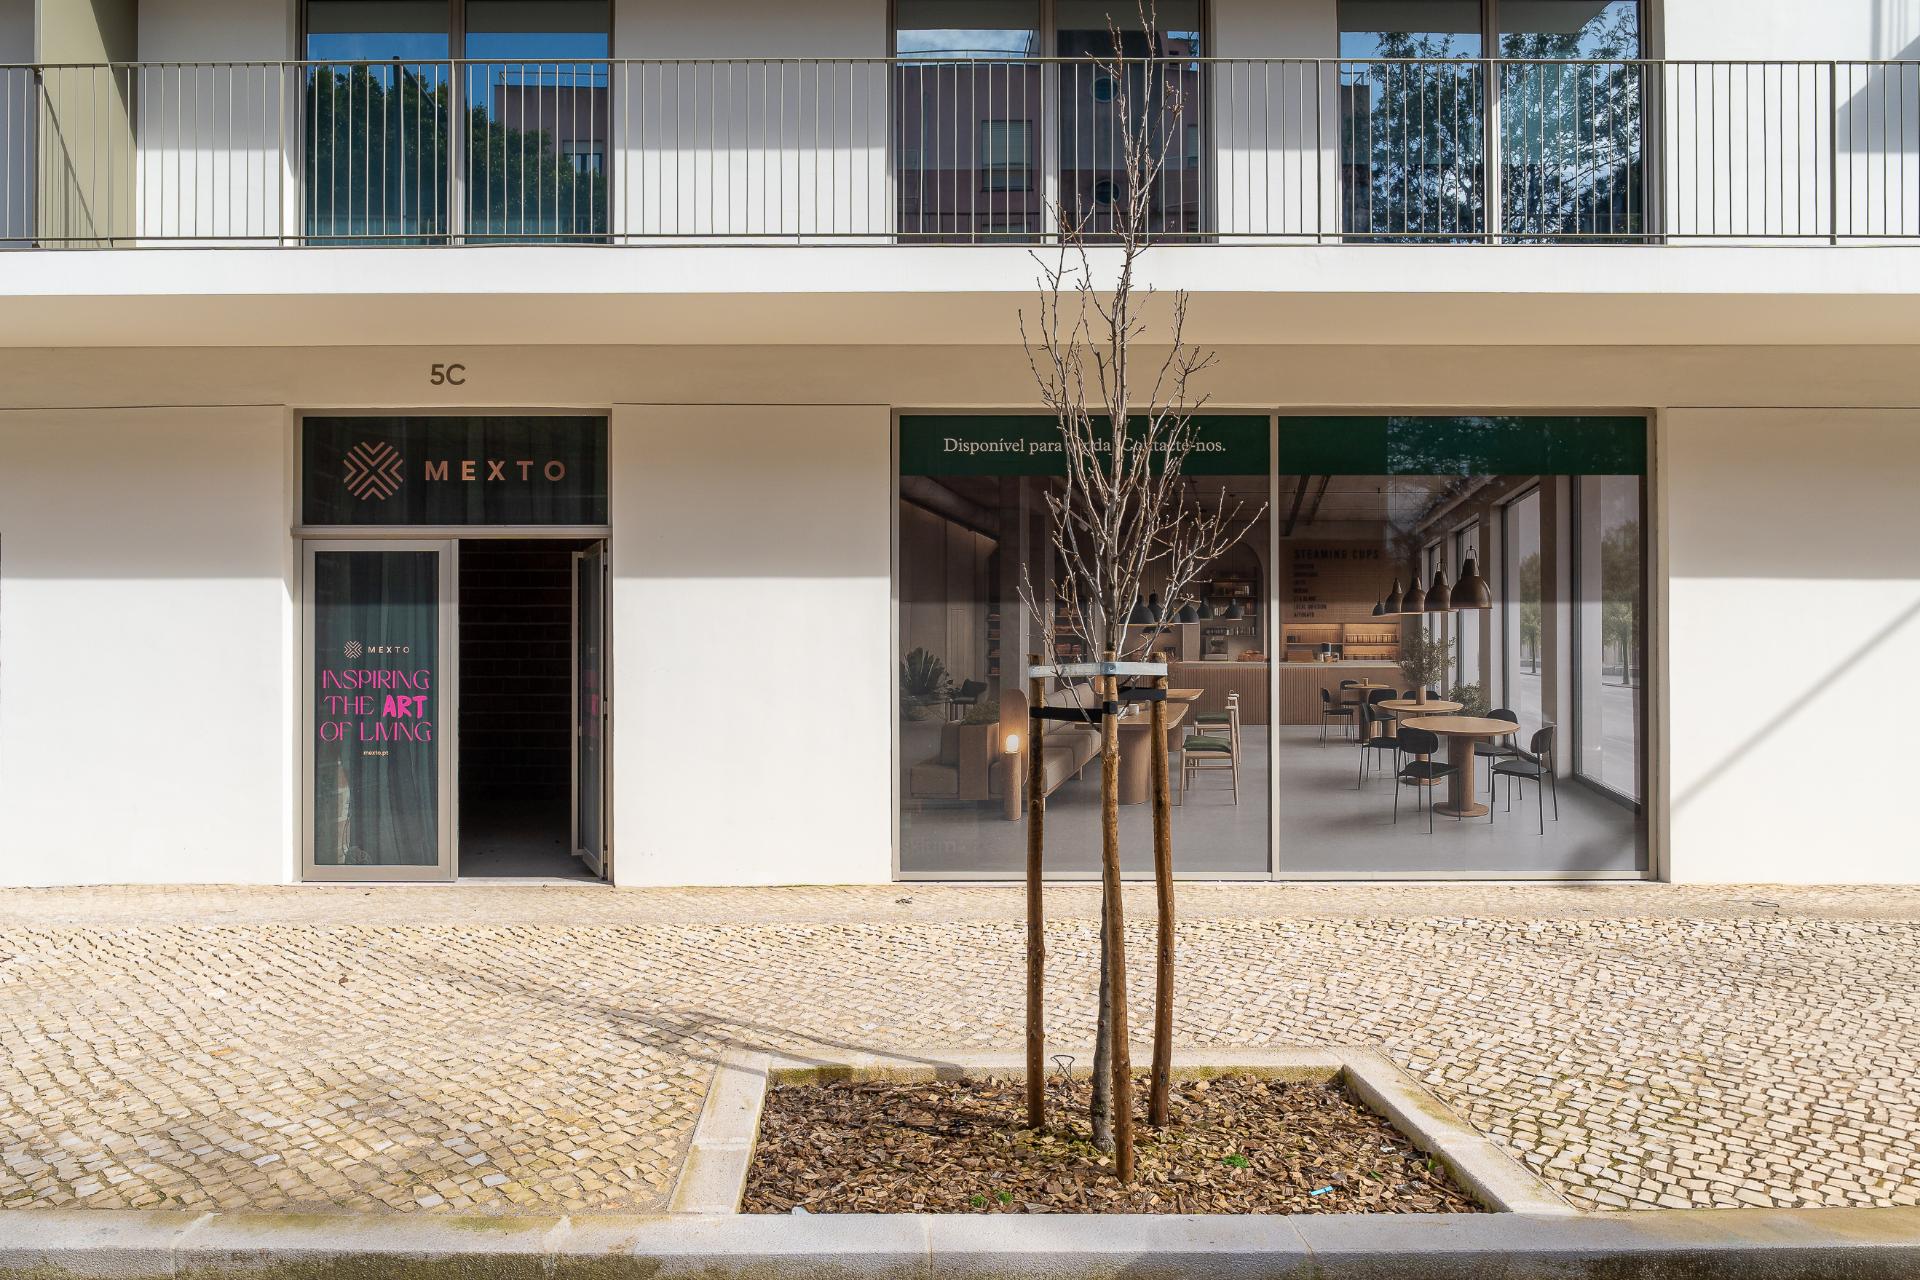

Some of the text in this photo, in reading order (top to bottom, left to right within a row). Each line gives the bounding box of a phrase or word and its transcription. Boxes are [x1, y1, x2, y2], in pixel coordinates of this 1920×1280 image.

[430, 364, 466, 385] 5C
[943, 438, 1025, 455] Disponível
[1029, 442, 1063, 455] para
[1068, 438, 1111, 452] nda
[424, 460, 567, 482] MEXTO
[1353, 549, 1379, 559] CUPS
[367, 646, 410, 654] MEXTO
[323, 670, 430, 690] INSPIRING
[323, 694, 428, 719] THE ART
[320, 721, 433, 742] OF LIVING
